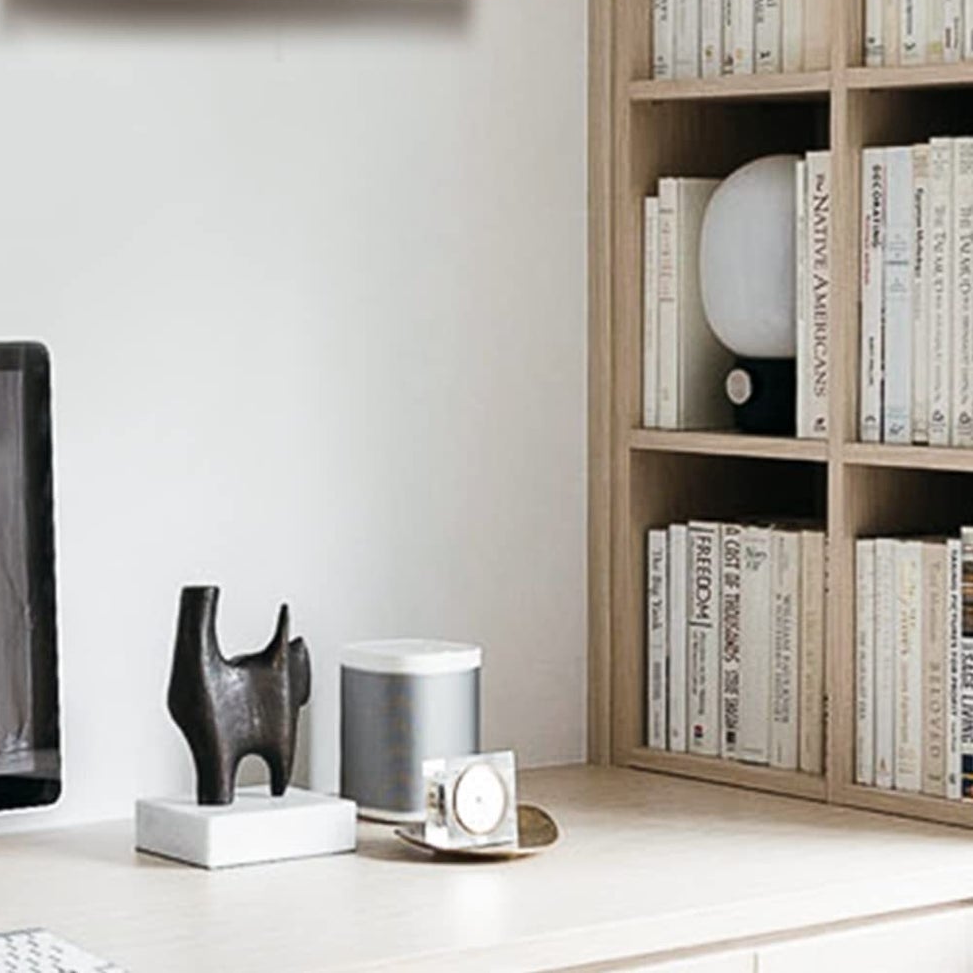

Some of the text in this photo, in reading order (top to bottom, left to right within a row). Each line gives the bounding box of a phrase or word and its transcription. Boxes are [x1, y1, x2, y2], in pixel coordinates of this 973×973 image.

[813, 194, 829, 272] NATIVE
[813, 274, 829, 398] AMERICANS
[694, 535, 713, 619] FREEDOM
